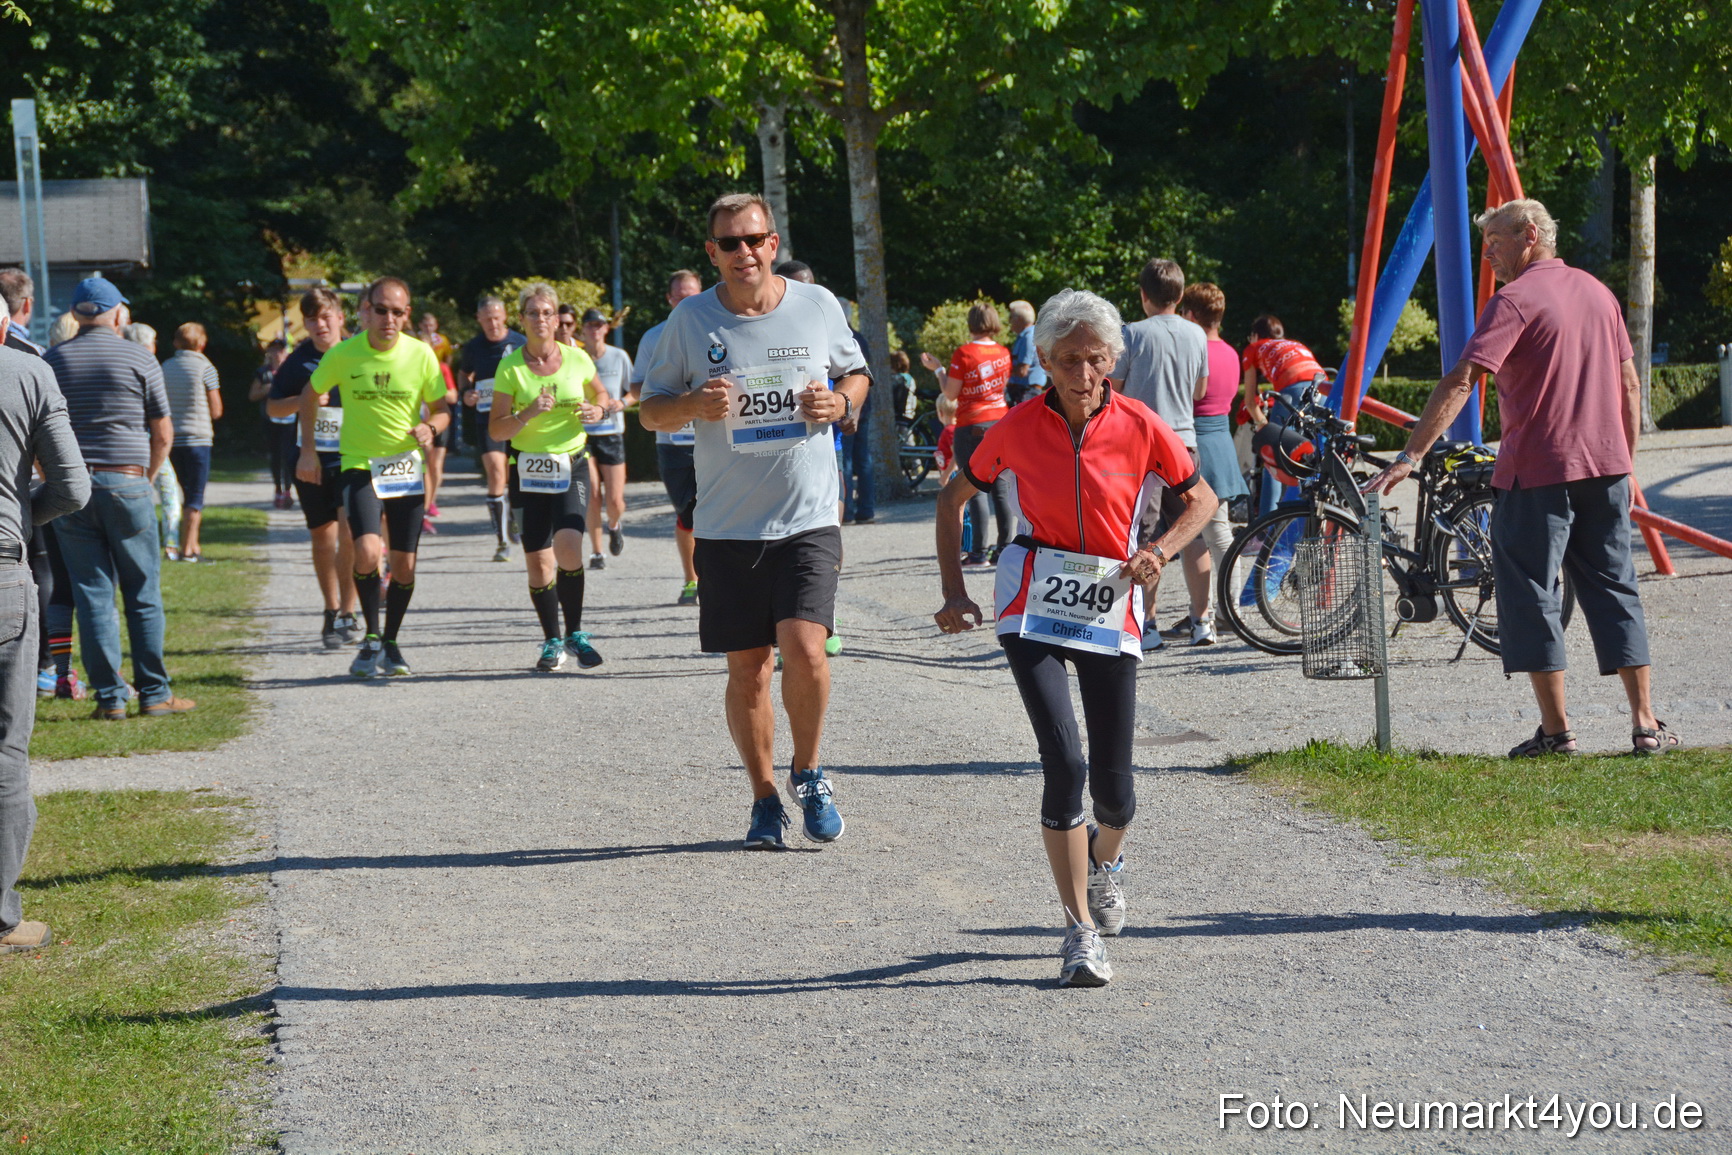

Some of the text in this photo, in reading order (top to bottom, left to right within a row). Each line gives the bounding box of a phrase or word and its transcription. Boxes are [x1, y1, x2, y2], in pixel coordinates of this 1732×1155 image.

[767, 347, 809, 358] BOCK
[709, 366, 730, 374] PARTL
[746, 375, 783, 387] BOCK
[738, 389, 796, 417] 2594
[314, 419, 339, 433] 385
[756, 428, 785, 439] Dieter
[378, 460, 414, 476] 2292
[526, 458, 560, 473] 2291
[1063, 561, 1105, 576] BOCK
[1042, 576, 1115, 613] 2349
[1047, 608, 1096, 622] PARTL Neumarkt
[1052, 622, 1093, 641] Christa
[1042, 816, 1058, 828] cep
